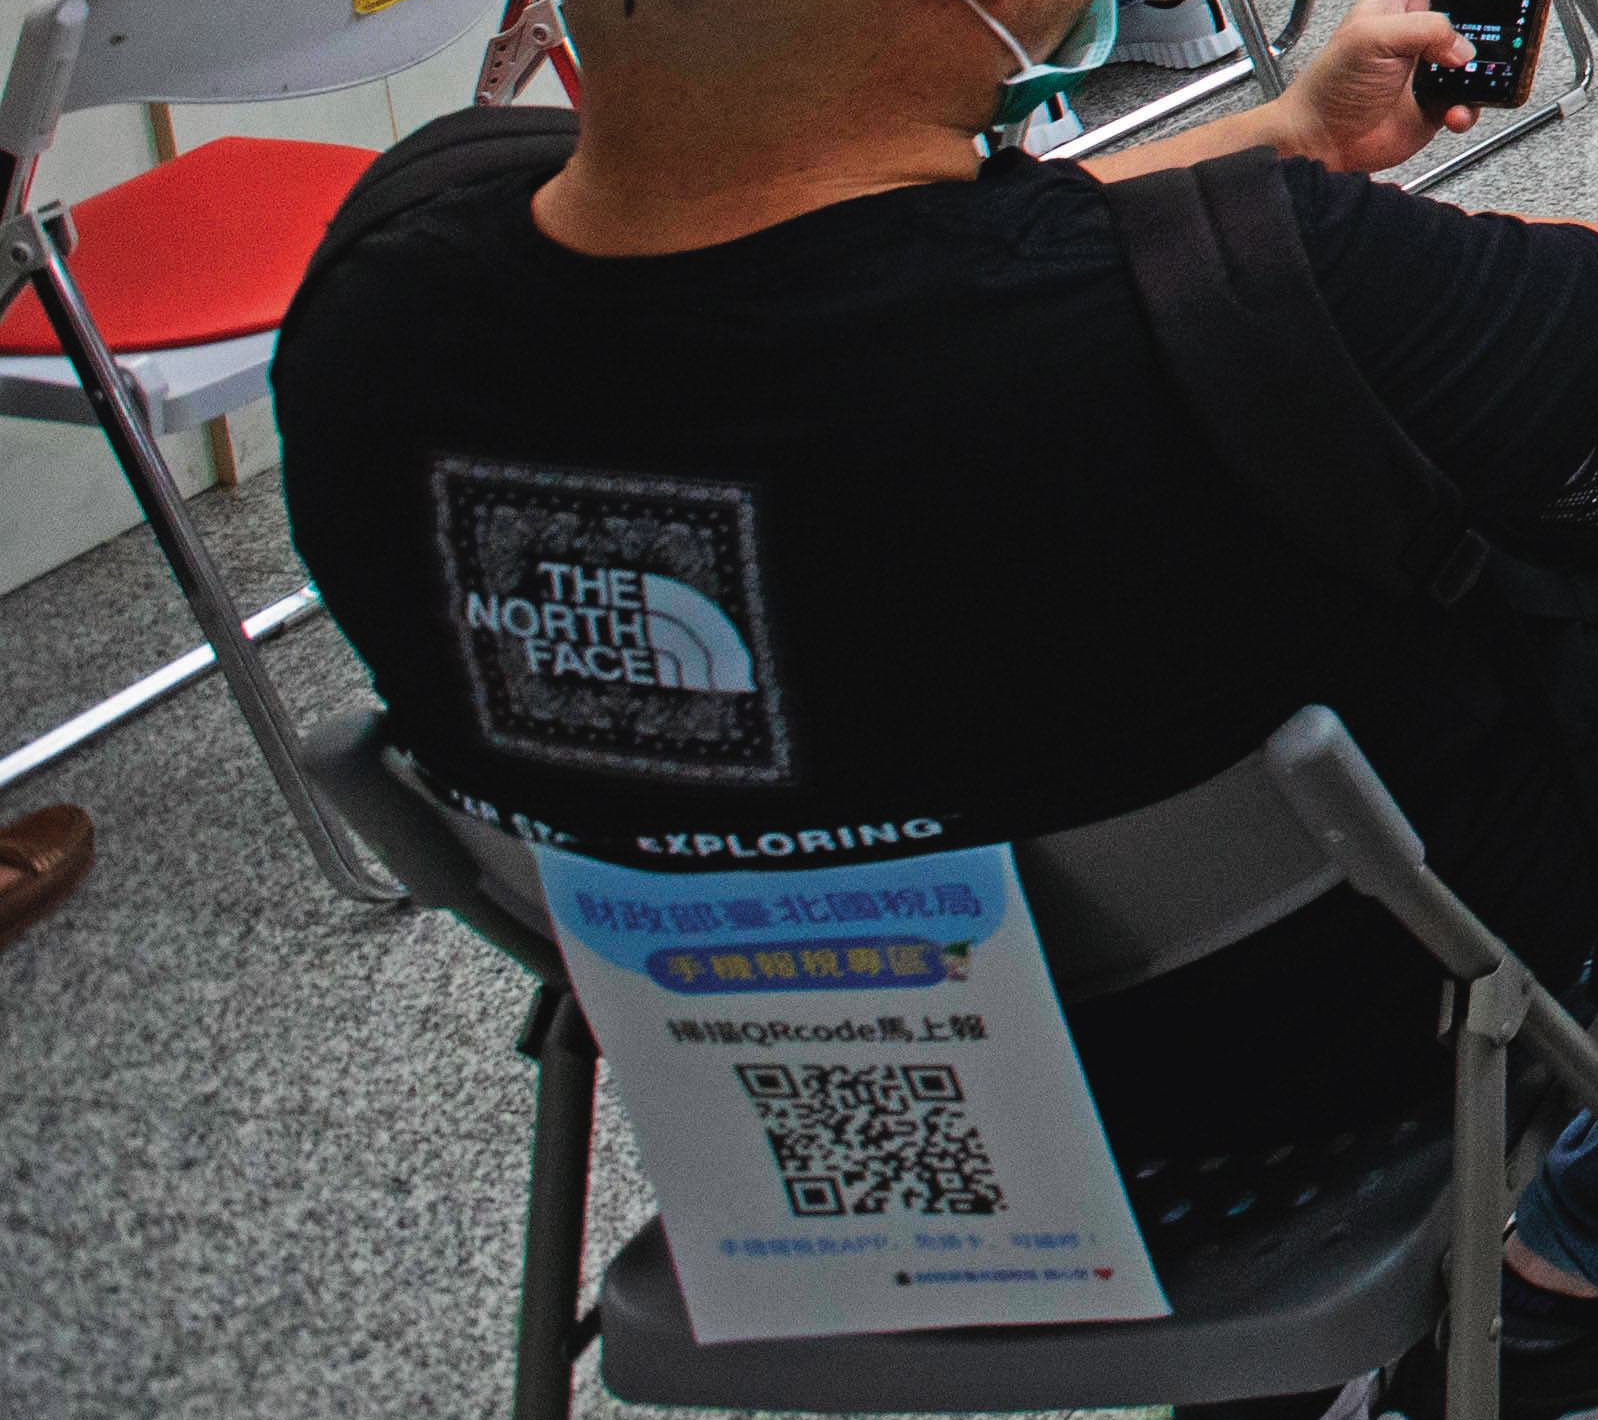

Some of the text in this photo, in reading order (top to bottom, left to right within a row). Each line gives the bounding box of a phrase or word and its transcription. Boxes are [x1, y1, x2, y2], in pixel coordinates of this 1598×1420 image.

[537, 560, 643, 610] THE
[466, 590, 646, 648] NORTH
[524, 640, 656, 688] FACE
[576, 882, 983, 937] 財政部臺北國稅局
[666, 940, 932, 984] 手機報稅專區
[667, 1013, 987, 1046] 掃描QRcode馬上報
